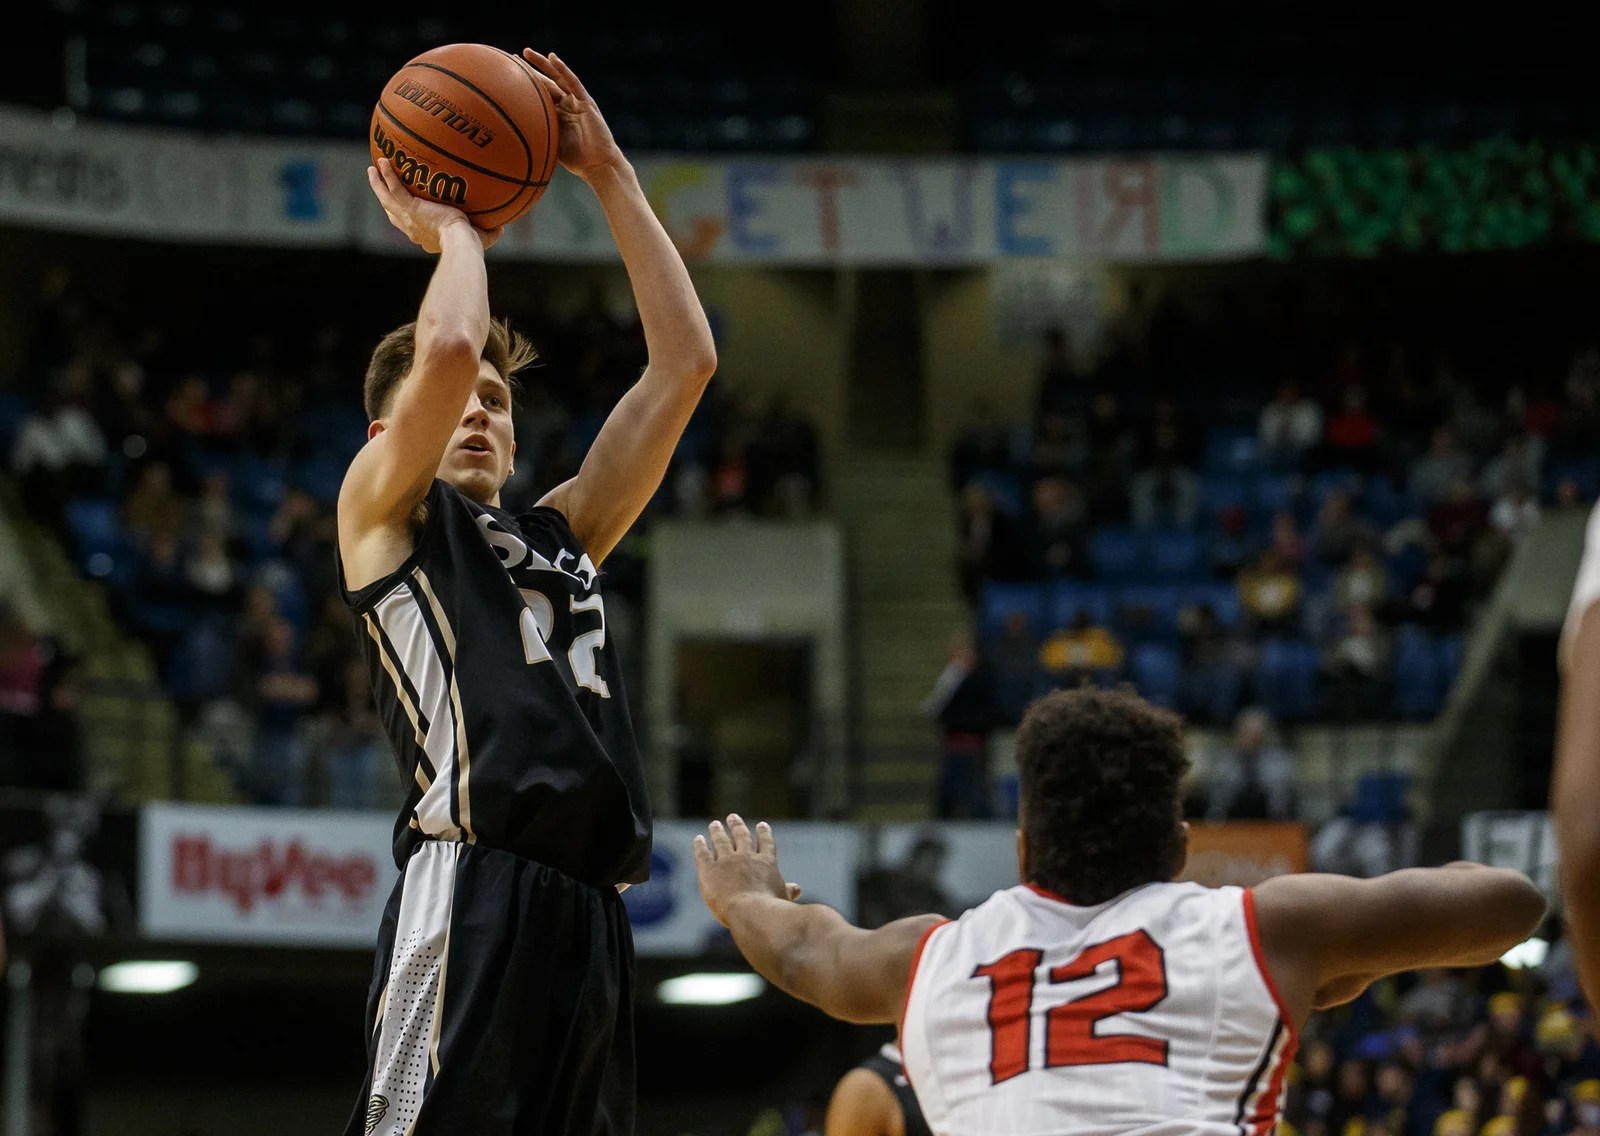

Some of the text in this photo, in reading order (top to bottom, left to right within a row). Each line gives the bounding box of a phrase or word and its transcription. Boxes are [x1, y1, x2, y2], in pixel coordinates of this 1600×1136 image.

[394, 80, 495, 149] EVOLUTION
[373, 119, 468, 205] Wilson
[650, 162, 864, 258] GET
[970, 927, 1169, 1086] 12
